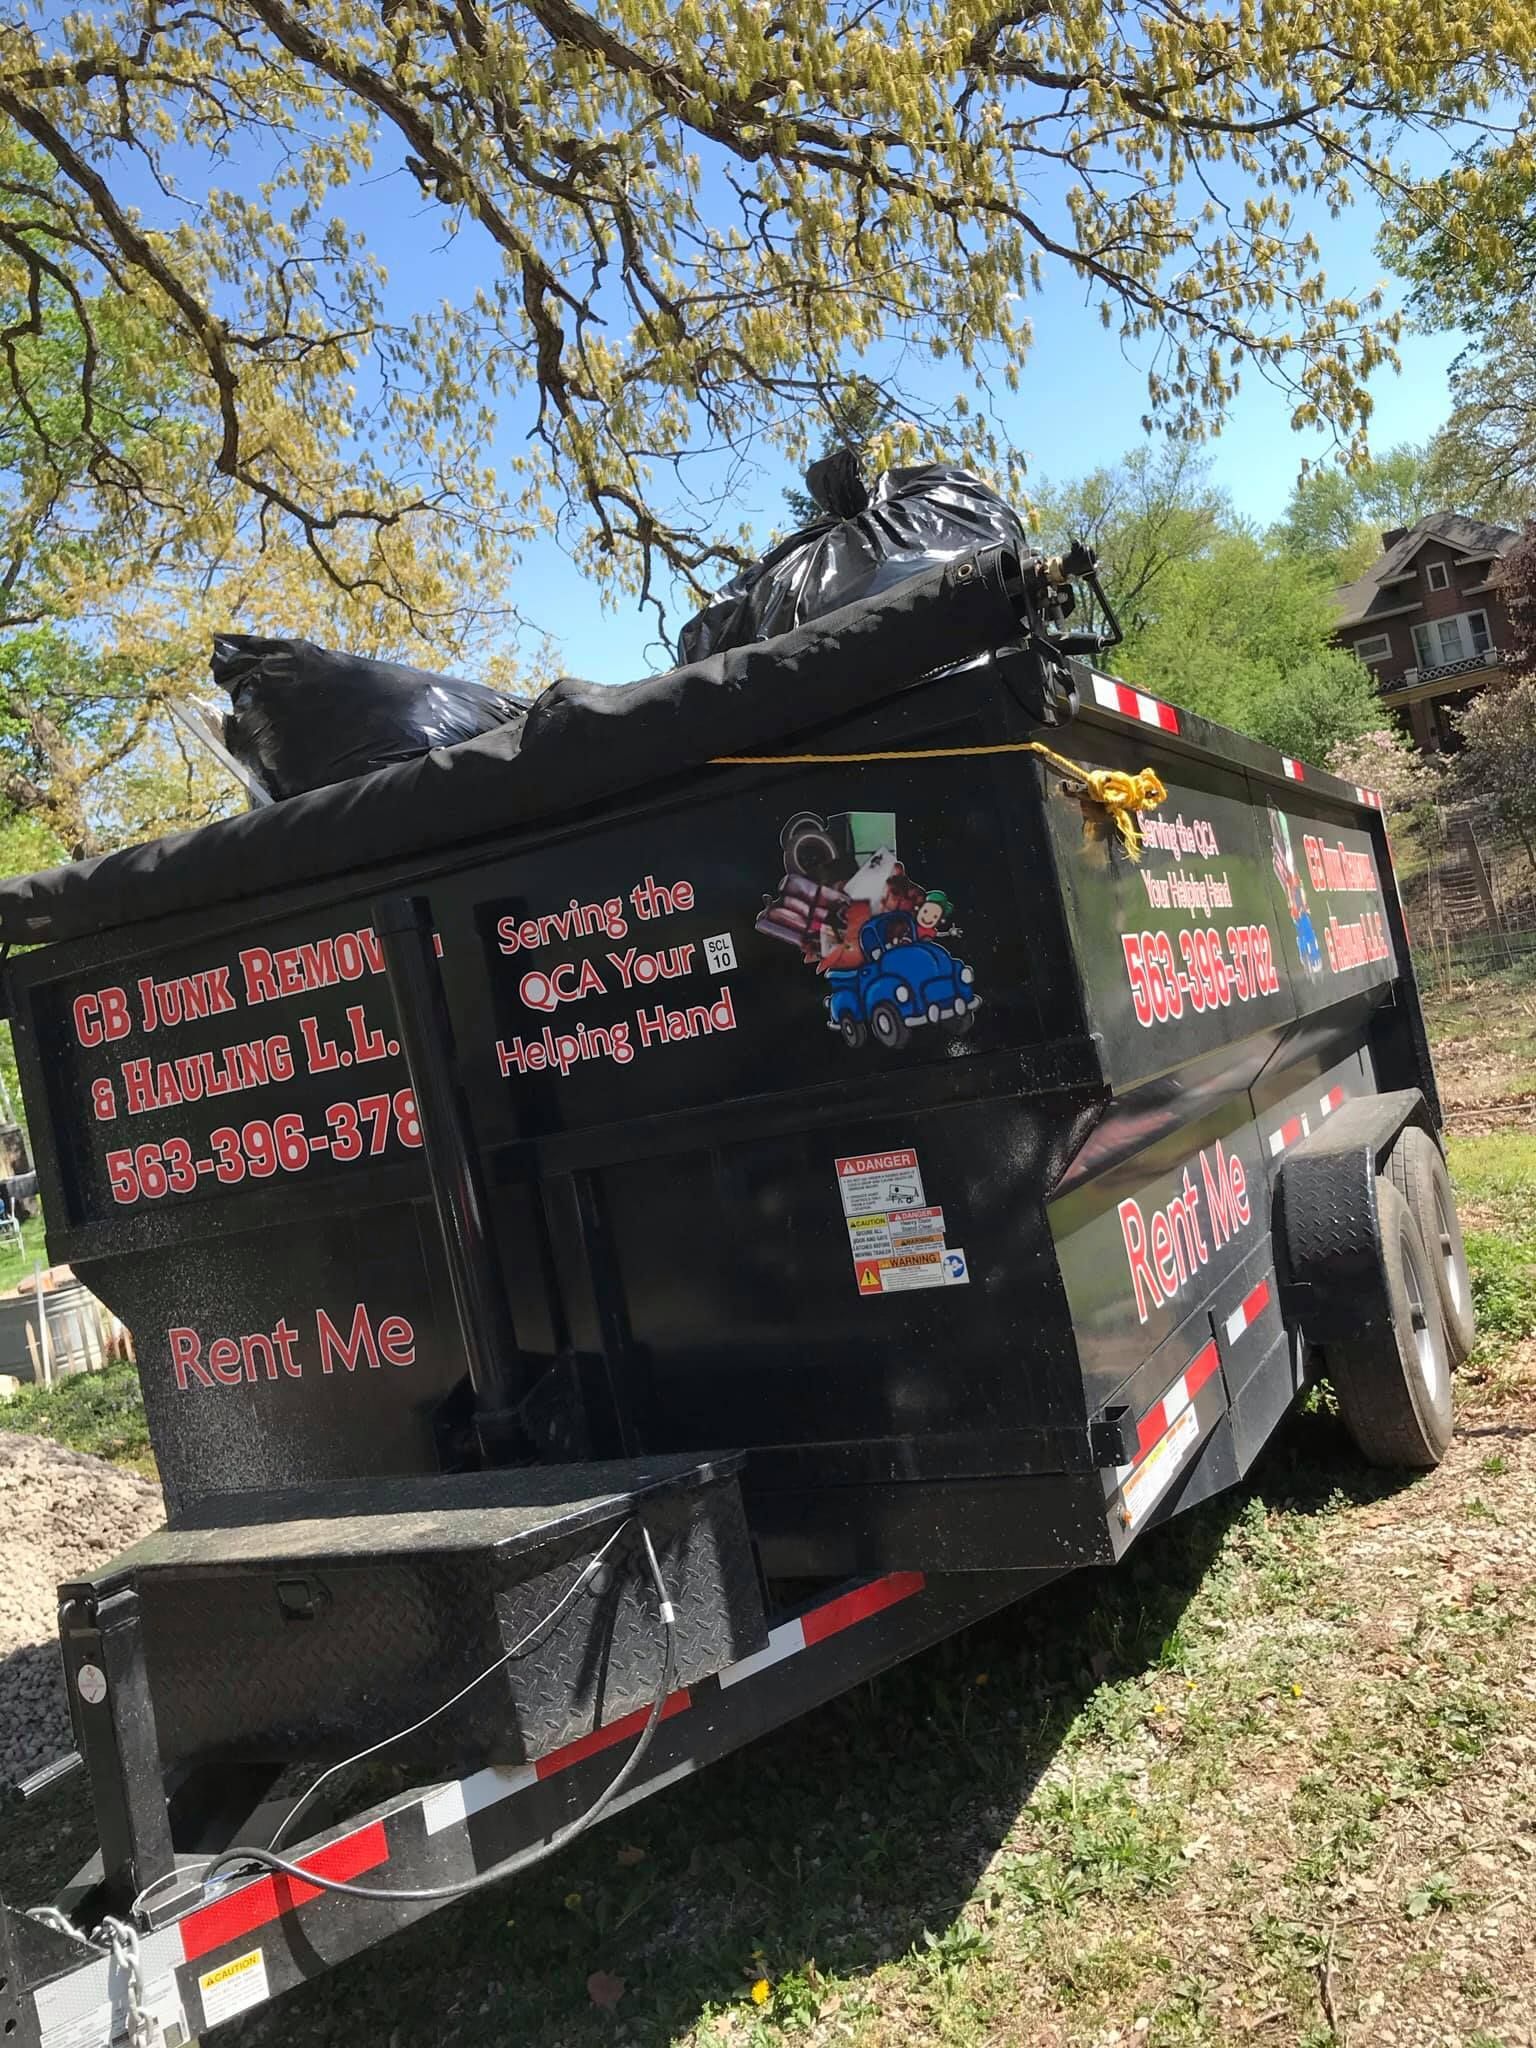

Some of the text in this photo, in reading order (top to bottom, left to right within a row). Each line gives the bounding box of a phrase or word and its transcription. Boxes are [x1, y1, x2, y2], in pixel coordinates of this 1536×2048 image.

[1136, 809, 1220, 862] Serving the QCA
[498, 876, 695, 955] Serving the
[1140, 868, 1233, 919] Your Helping Hand
[519, 941, 696, 1012] QCA Your
[708, 938, 730, 953] SCL
[713, 952, 731, 969] 10
[1121, 924, 1280, 1028] 563-396-3782
[73, 986, 132, 1048] CB
[239, 927, 444, 1007] REMOV
[91, 1005, 401, 1121] & HAULING L.L.
[495, 987, 737, 1078] Helping Hand
[106, 1088, 425, 1205] 563-396-378
[856, 1154, 911, 1172] DANGER
[855, 1217, 886, 1227] CAUTION
[901, 1209, 932, 1220] DANGER
[1117, 1138, 1251, 1325] Rent Me
[889, 1253, 938, 1268] WARNING
[168, 1303, 416, 1390] Rent Me
[214, 1955, 257, 1982] CAUTION
